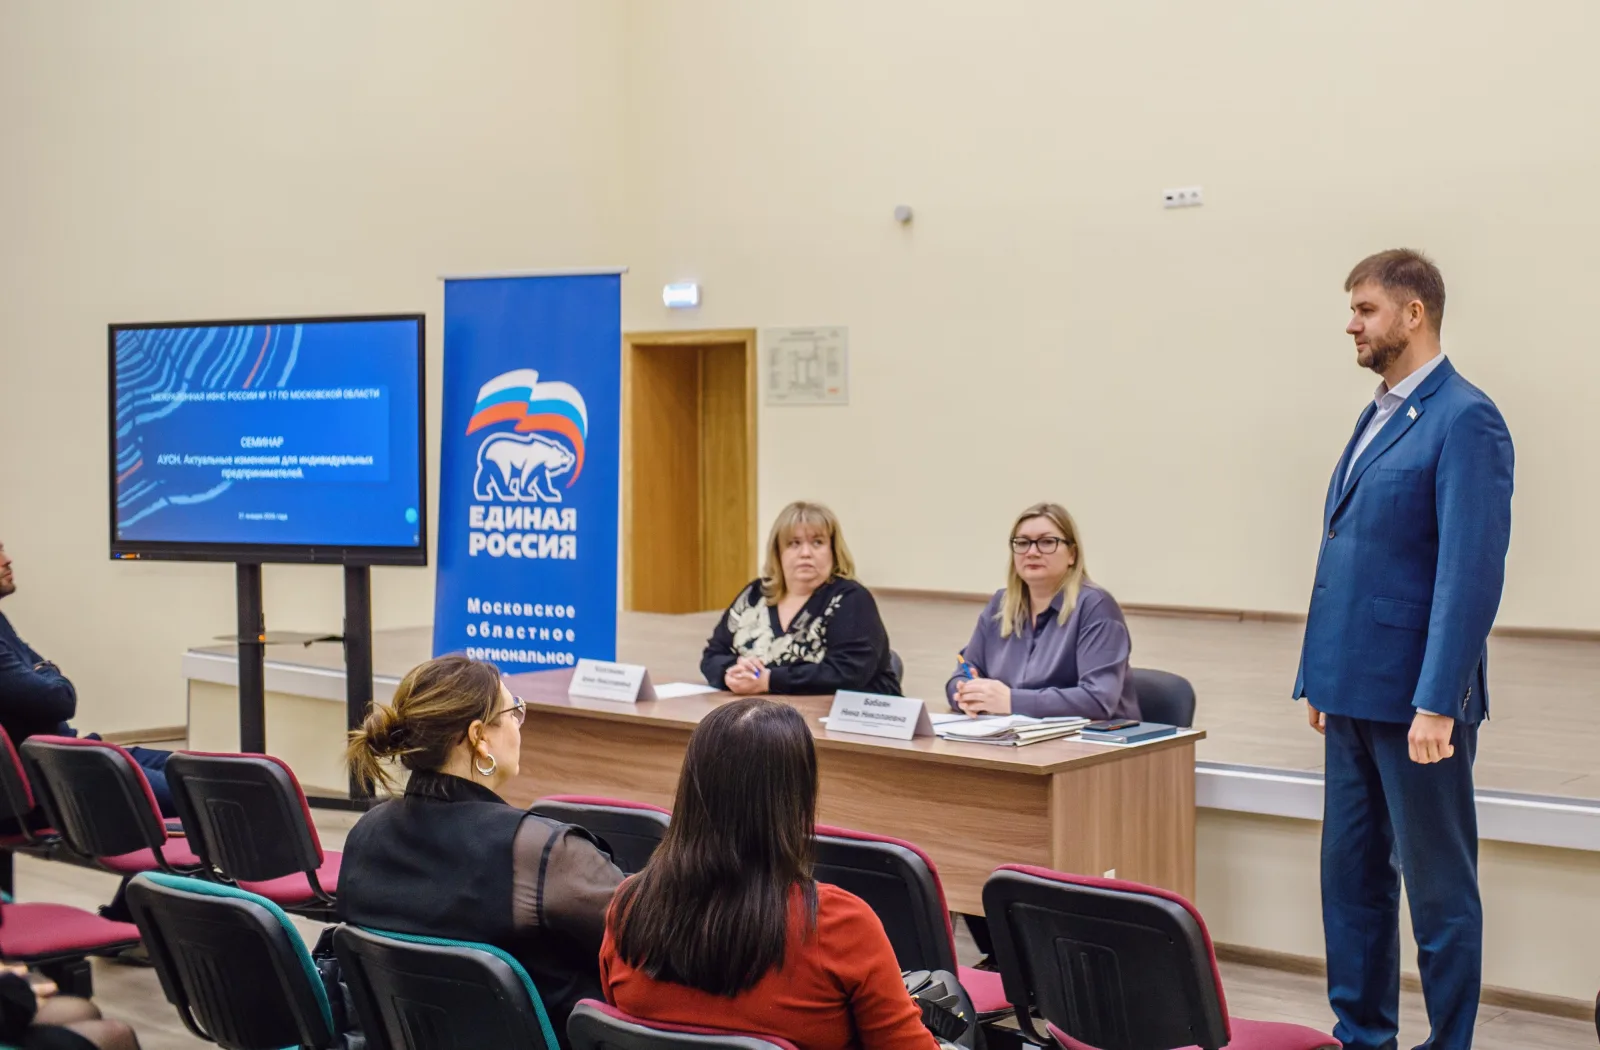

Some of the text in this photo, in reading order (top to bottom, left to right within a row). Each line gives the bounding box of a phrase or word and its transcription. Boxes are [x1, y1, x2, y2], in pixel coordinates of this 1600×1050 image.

[228, 390, 257, 400] РОССИИ
[268, 390, 276, 399] 17
[278, 390, 288, 399] ПО
[290, 388, 342, 400] МОСКОВСКОЙ
[344, 388, 380, 399] ОБЛАСТИ
[240, 436, 284, 448] СЕМИНАР
[183, 454, 232, 468] Актуальные
[234, 455, 280, 465] изменения
[282, 455, 298, 466] для
[299, 454, 373, 468] индивидуальных
[469, 505, 577, 532] ЕДИНАЯ
[468, 532, 577, 560] РОССИЯ
[467, 597, 576, 618] Московское
[466, 620, 576, 642] областное
[466, 646, 575, 666] региональное
[864, 698, 890, 708] Бабаян
[841, 708, 906, 722] Нина Николаевна
